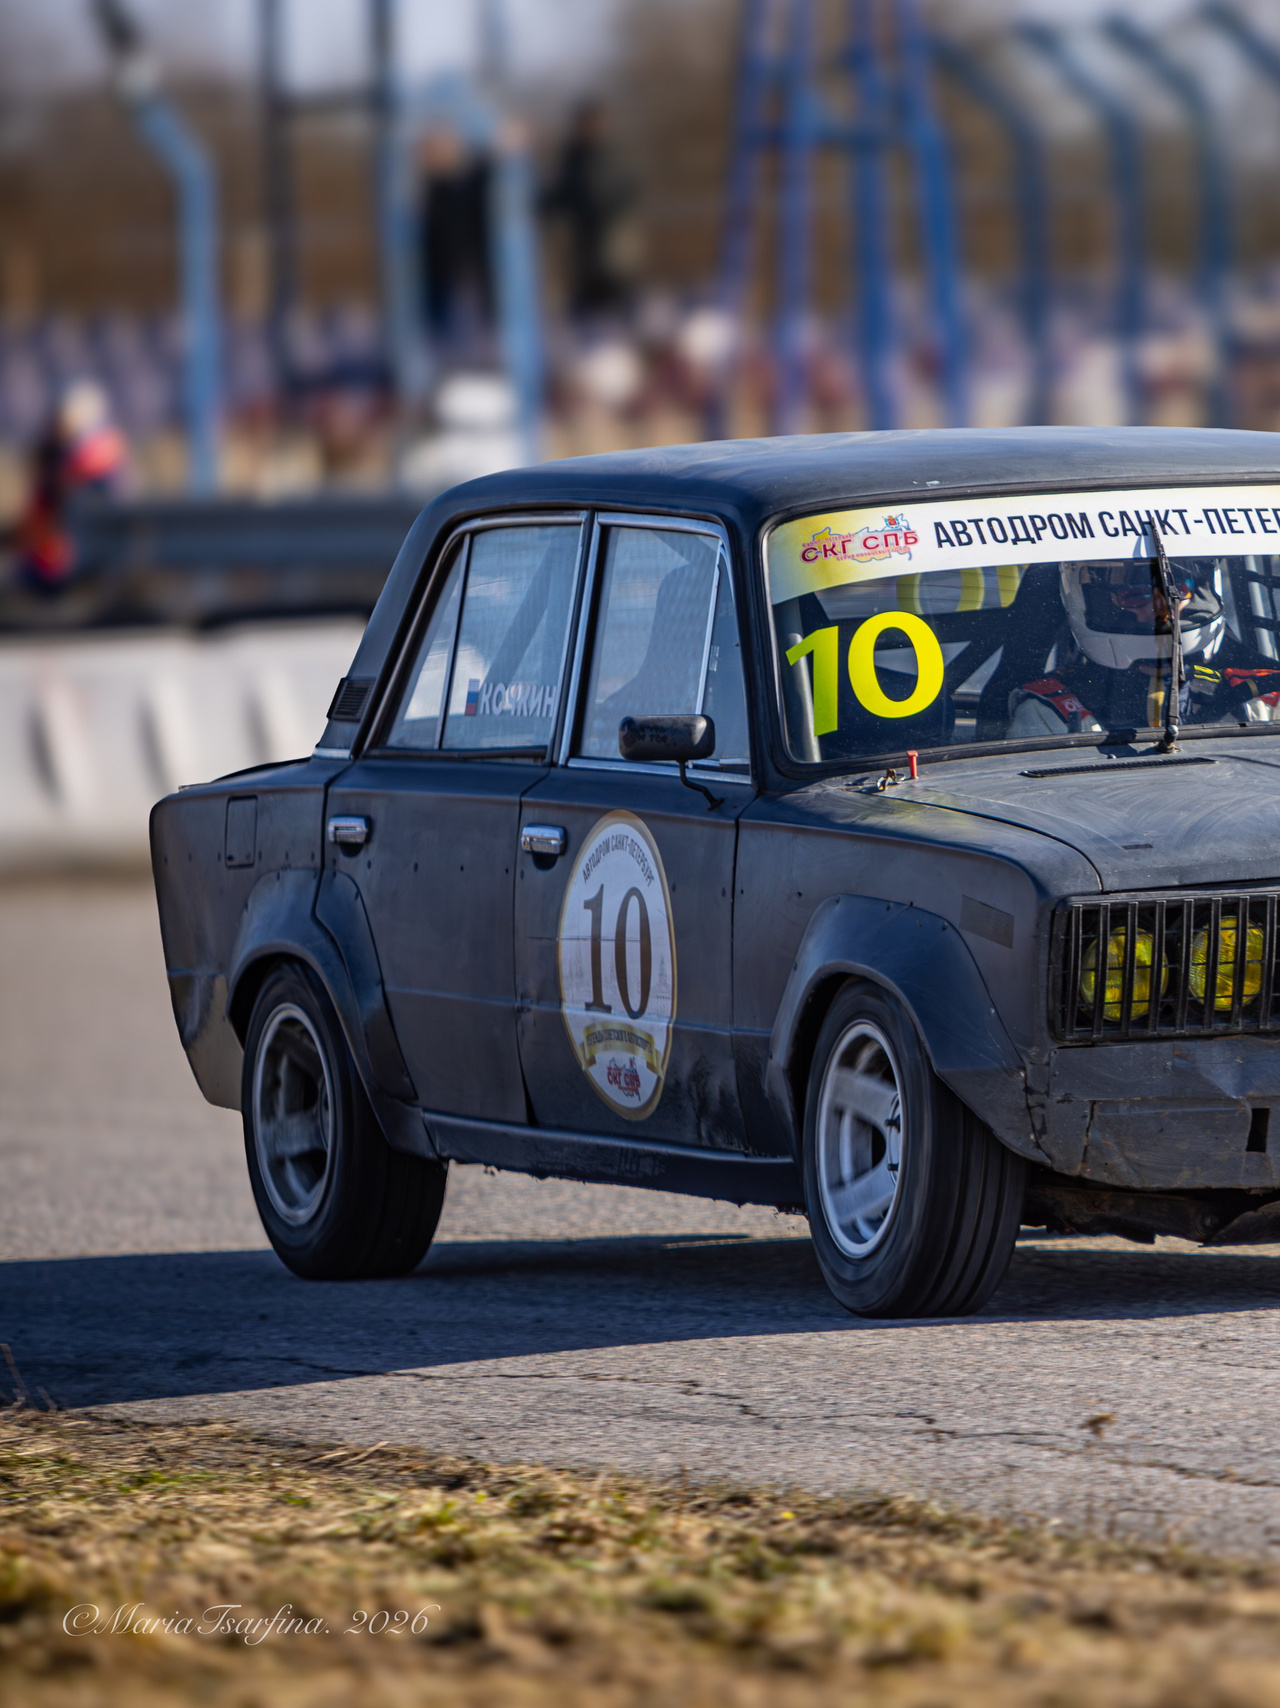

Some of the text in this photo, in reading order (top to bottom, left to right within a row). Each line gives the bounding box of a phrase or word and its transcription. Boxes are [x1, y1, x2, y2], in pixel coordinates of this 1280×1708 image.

[801, 539, 852, 562] СКГ
[862, 530, 919, 550] СПБ
[933, 512, 1096, 549] АВТОДРОМ
[785, 611, 945, 737] 10
[479, 682, 557, 717] КОЧКИН
[582, 837, 610, 884] АВТОДРОМ
[583, 883, 652, 1020] 10
